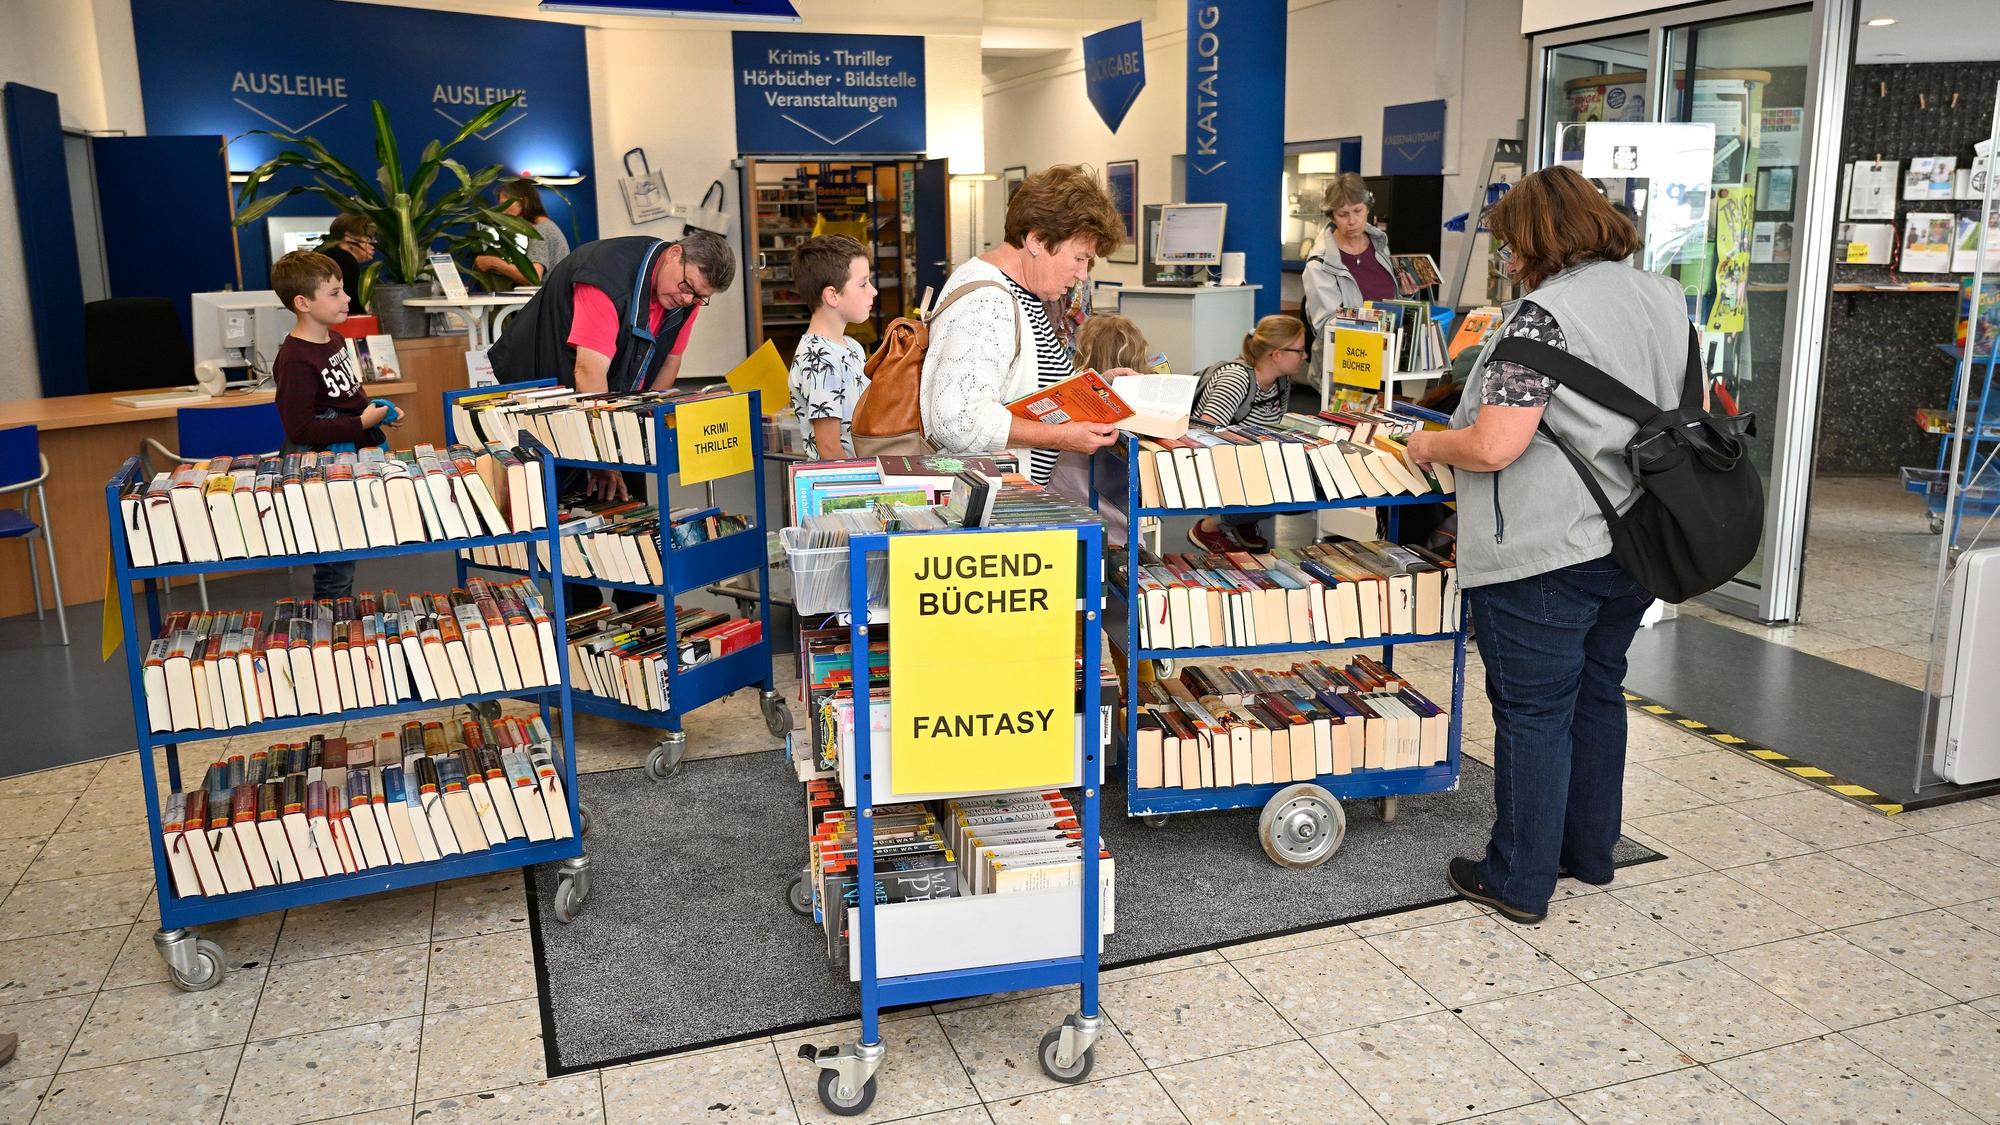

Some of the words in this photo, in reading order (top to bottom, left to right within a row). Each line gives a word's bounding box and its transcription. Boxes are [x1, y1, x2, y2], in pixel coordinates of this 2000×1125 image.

[768, 49, 821, 67] Krimis
[834, 49, 892, 68] Thriller
[231, 71, 347, 99] AUSLEIHE
[743, 69, 833, 88] Hörbücher
[845, 71, 917, 89] Bildstelle
[1198, 6, 1219, 155] KATALOG
[432, 83, 528, 108] AUSLEIHE
[765, 91, 898, 111] Veranstaltungen
[1346, 346, 1368, 358] SACH-
[1342, 359, 1370, 372] BÜCHER
[703, 422, 729, 437] KRIMI
[694, 436, 738, 454] THRILLER
[914, 552, 1053, 581] JUGEND-
[919, 586, 1048, 616] BÜCHER
[913, 708, 1055, 739] FANTASY
